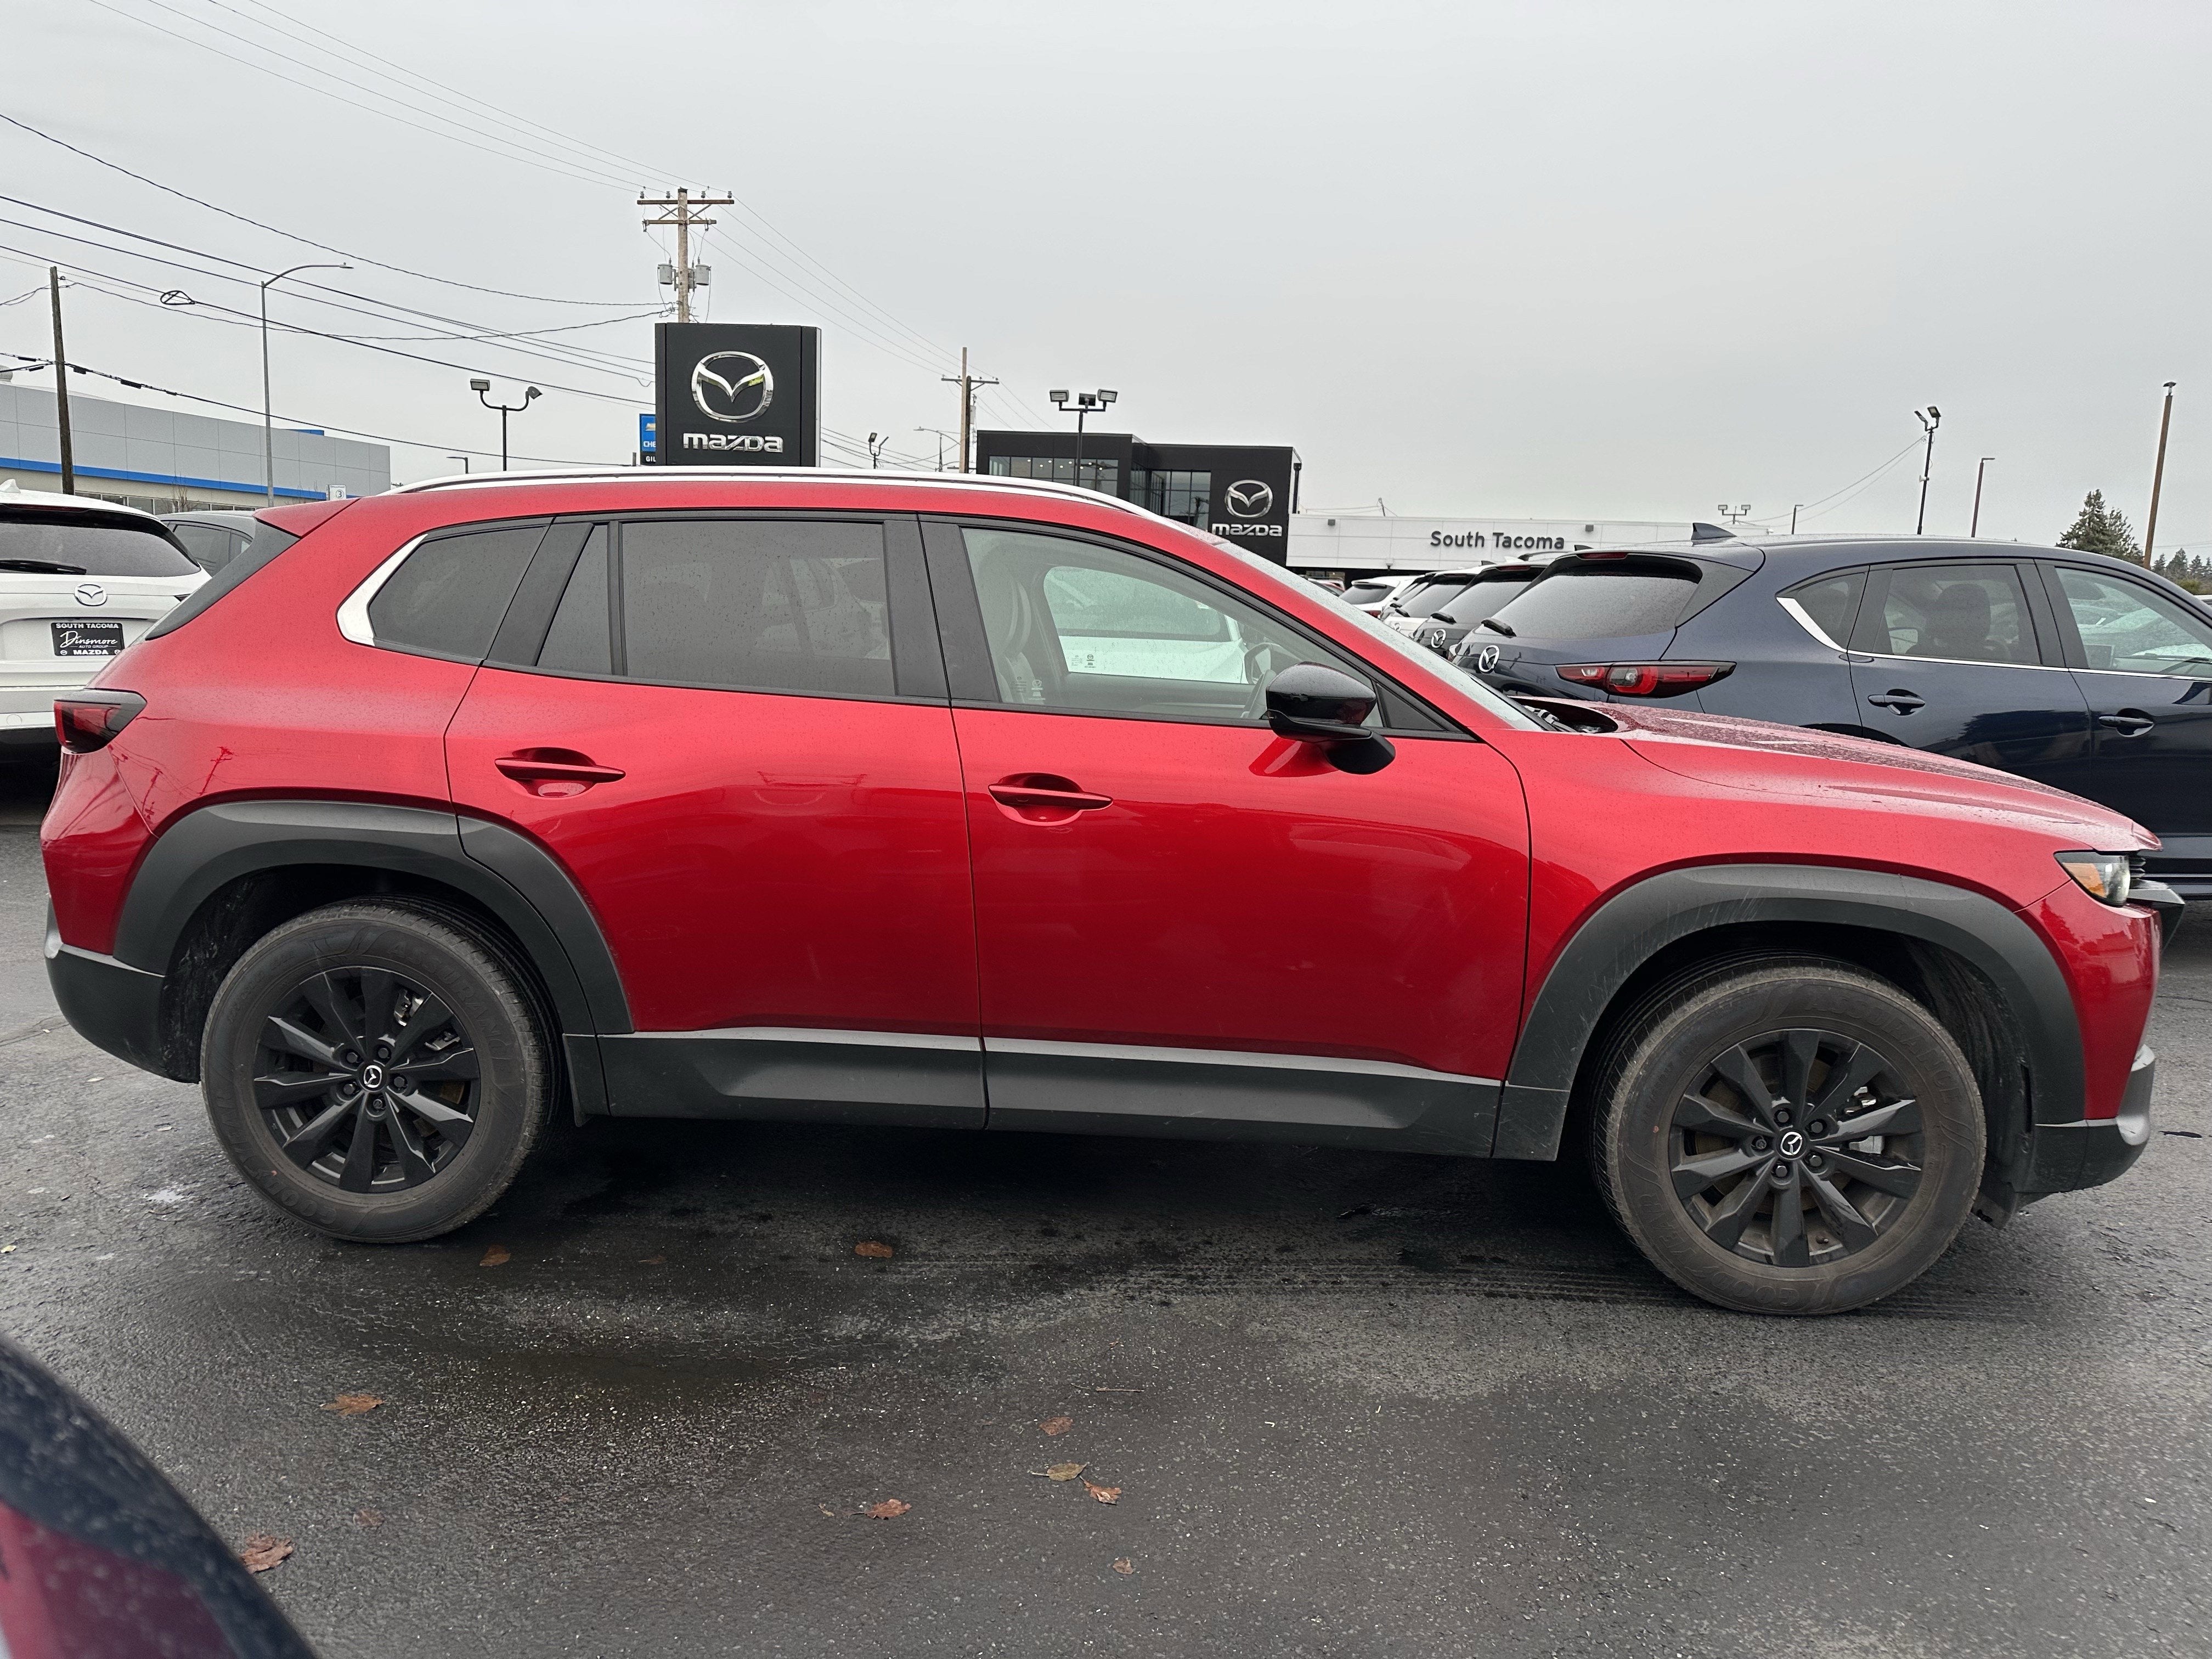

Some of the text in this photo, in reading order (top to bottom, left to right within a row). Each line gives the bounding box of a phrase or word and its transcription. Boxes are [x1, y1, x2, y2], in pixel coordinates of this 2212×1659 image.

[683, 433, 783, 453] mazda
[1212, 523, 1283, 537] mazda
[1430, 531, 1565, 549] South Tacoma
[59, 630, 118, 648] Dinsmore
